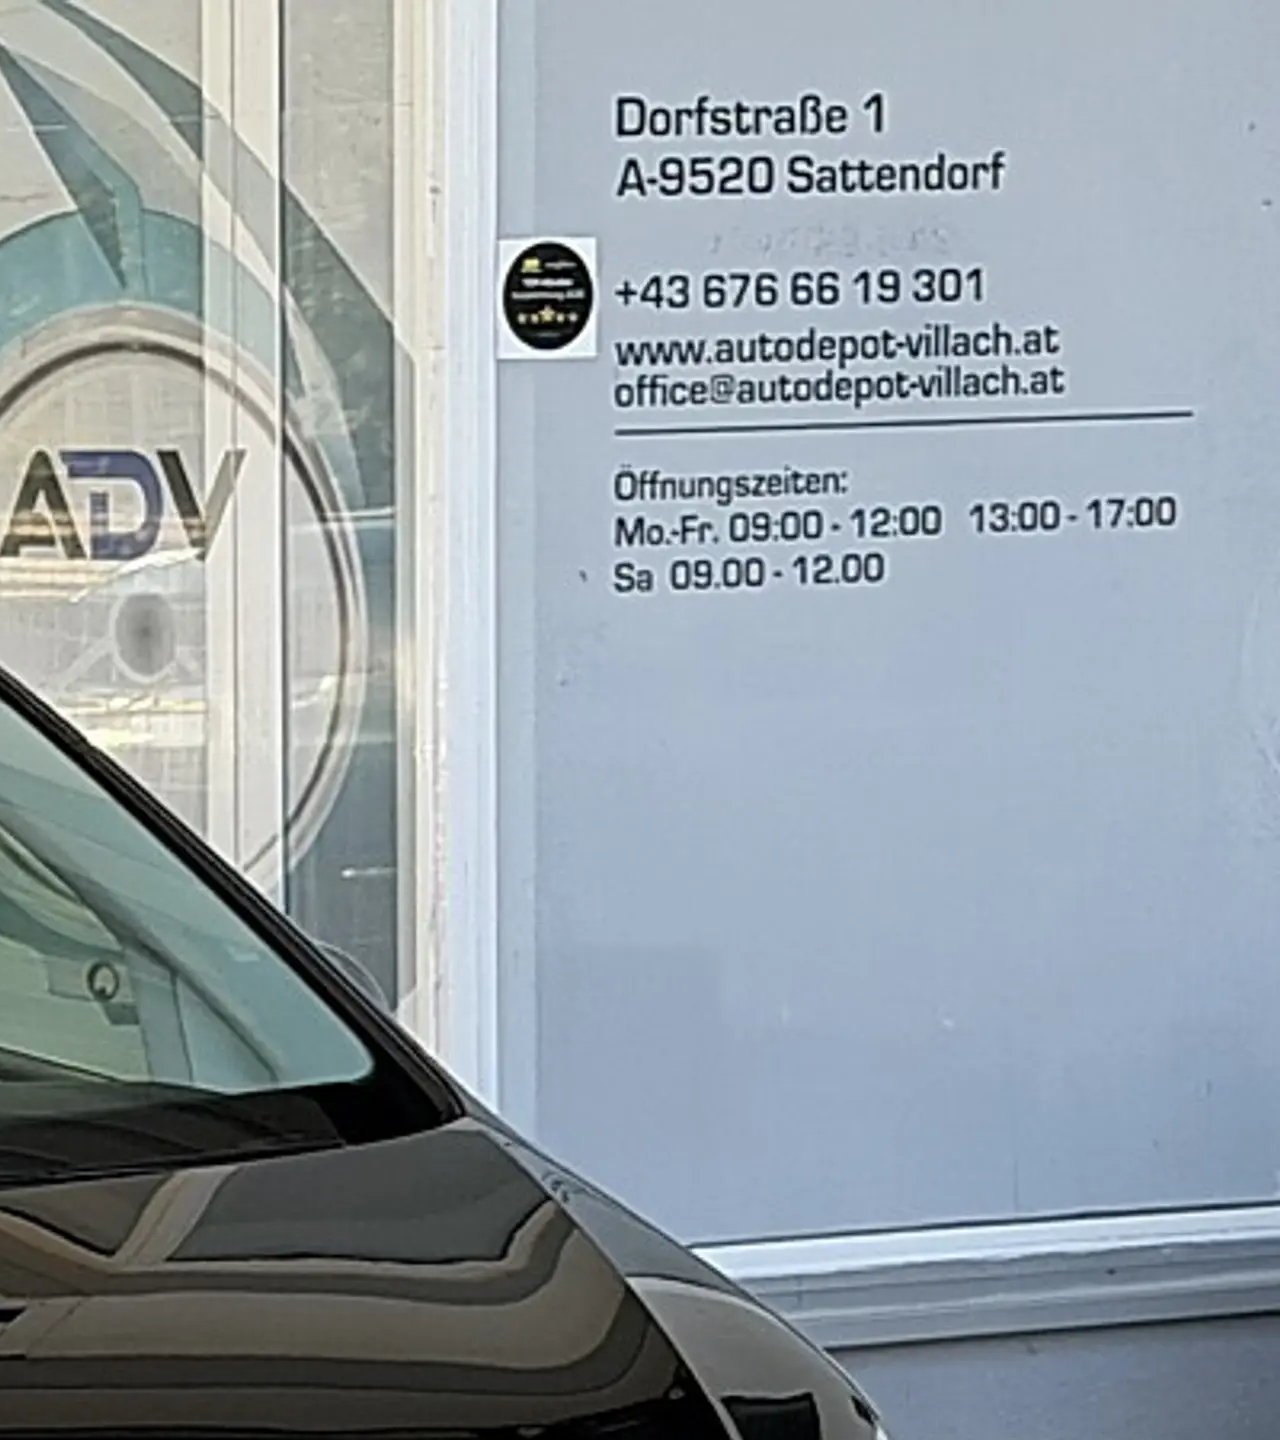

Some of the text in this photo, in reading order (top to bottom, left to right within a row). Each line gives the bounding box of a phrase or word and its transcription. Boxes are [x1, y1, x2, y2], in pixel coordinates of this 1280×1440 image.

[615, 92, 884, 137] Dorfstraße 1
[615, 150, 1006, 197] A-9520 Sattendorf
[614, 267, 983, 309] +43 676 66 19 301
[614, 322, 1060, 370] www.autodepot-villach.at
[613, 364, 1066, 410] office@autodepot-villach.at
[613, 463, 848, 507] Öffnungszeiten:
[614, 513, 720, 547] Mo.-Fr.
[728, 509, 824, 543] 09:00
[849, 505, 943, 539] 12:00
[968, 500, 1062, 534] 13:00
[1086, 496, 1177, 530] 17:00
[613, 561, 654, 594] Sa
[669, 557, 766, 590] 09.00
[791, 552, 885, 585] 12.00
